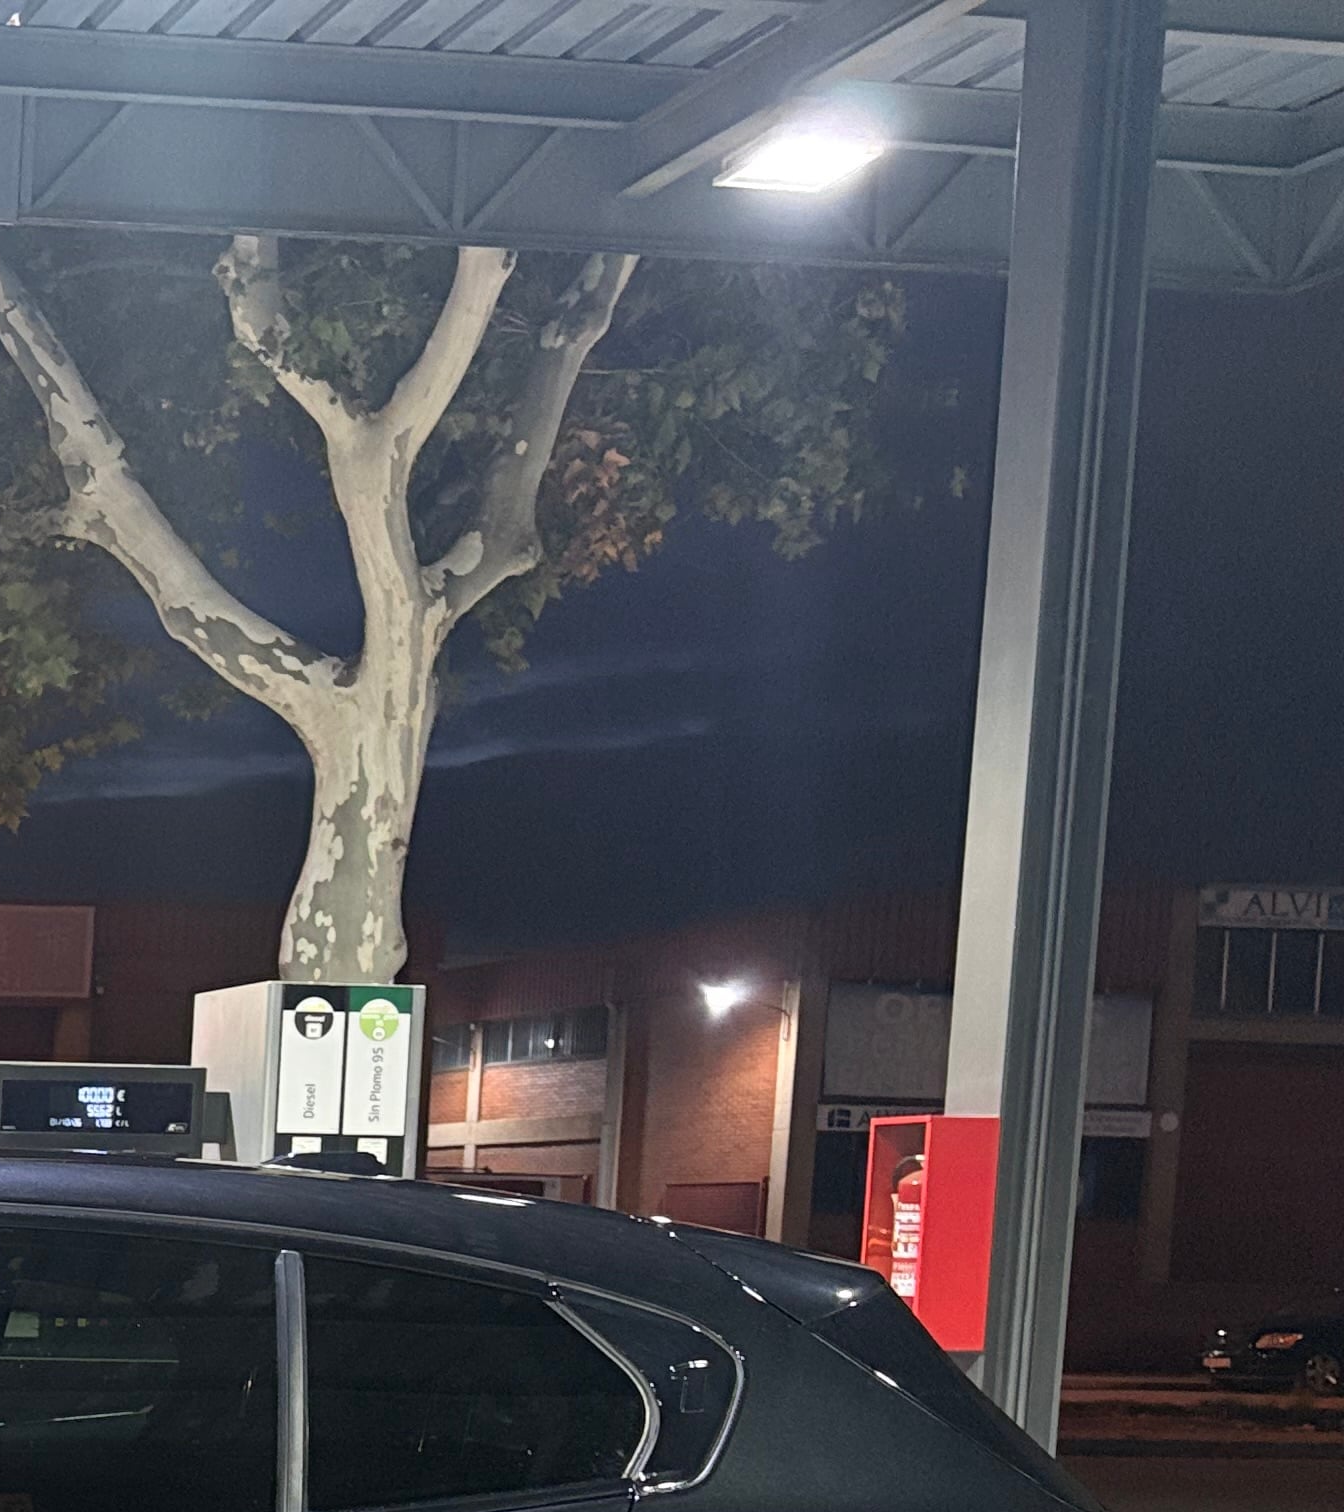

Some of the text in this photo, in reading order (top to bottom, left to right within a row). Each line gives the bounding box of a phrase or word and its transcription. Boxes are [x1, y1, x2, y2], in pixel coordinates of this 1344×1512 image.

[372, 1047, 384, 1062] 95
[303, 1083, 316, 1119] Diesel
[370, 1065, 384, 1102] Plomo
